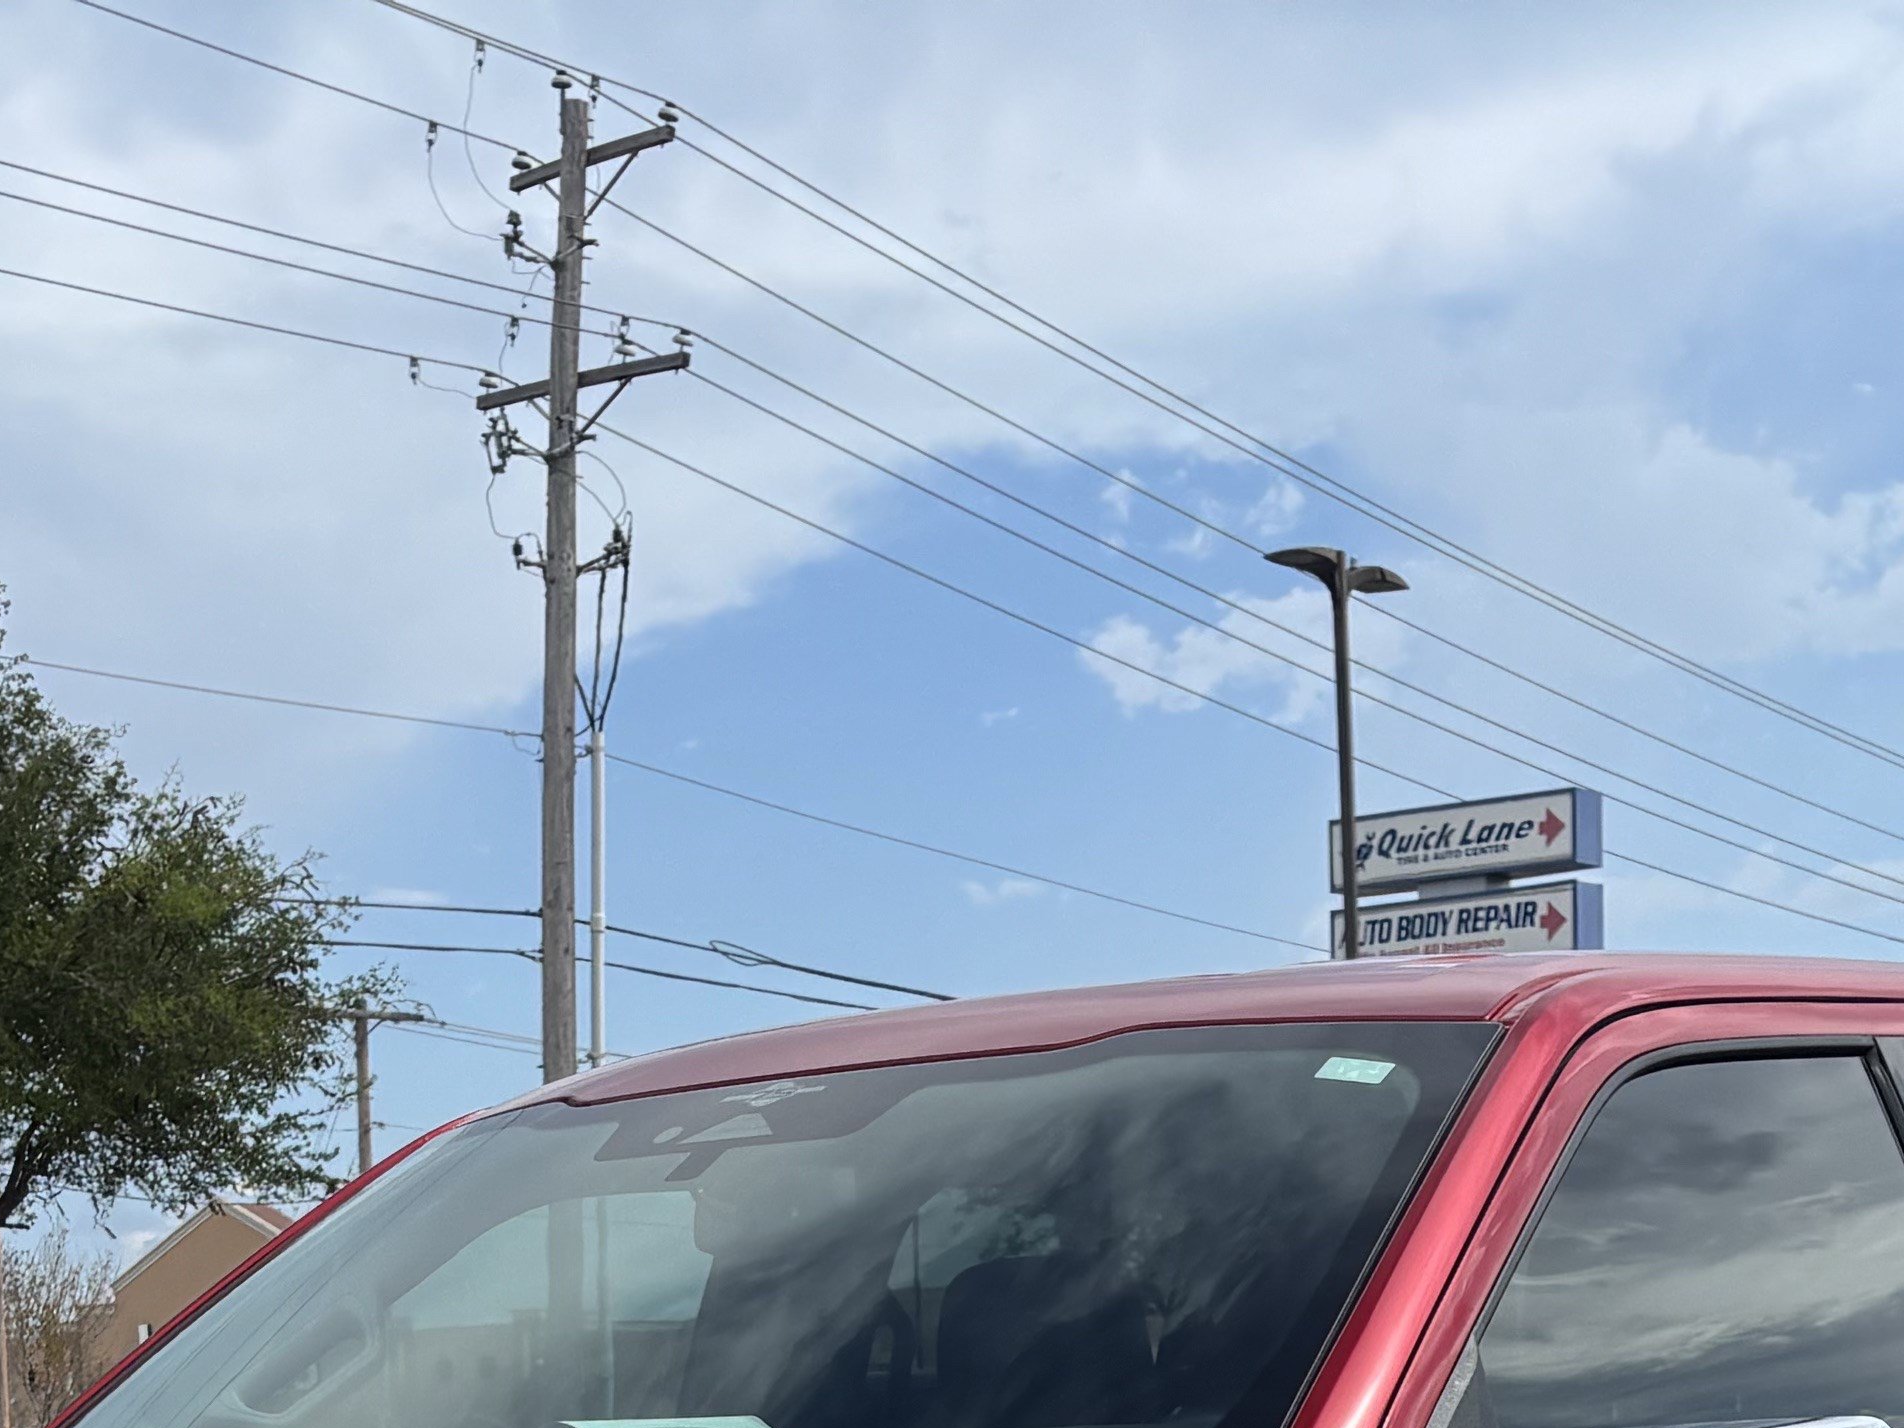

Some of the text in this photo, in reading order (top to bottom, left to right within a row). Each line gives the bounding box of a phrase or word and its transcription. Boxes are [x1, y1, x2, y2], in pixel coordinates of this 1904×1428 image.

[1378, 819, 1534, 859] Quick Lane
[1397, 908, 1454, 943] BODY
[1457, 901, 1537, 935] REPAIR
